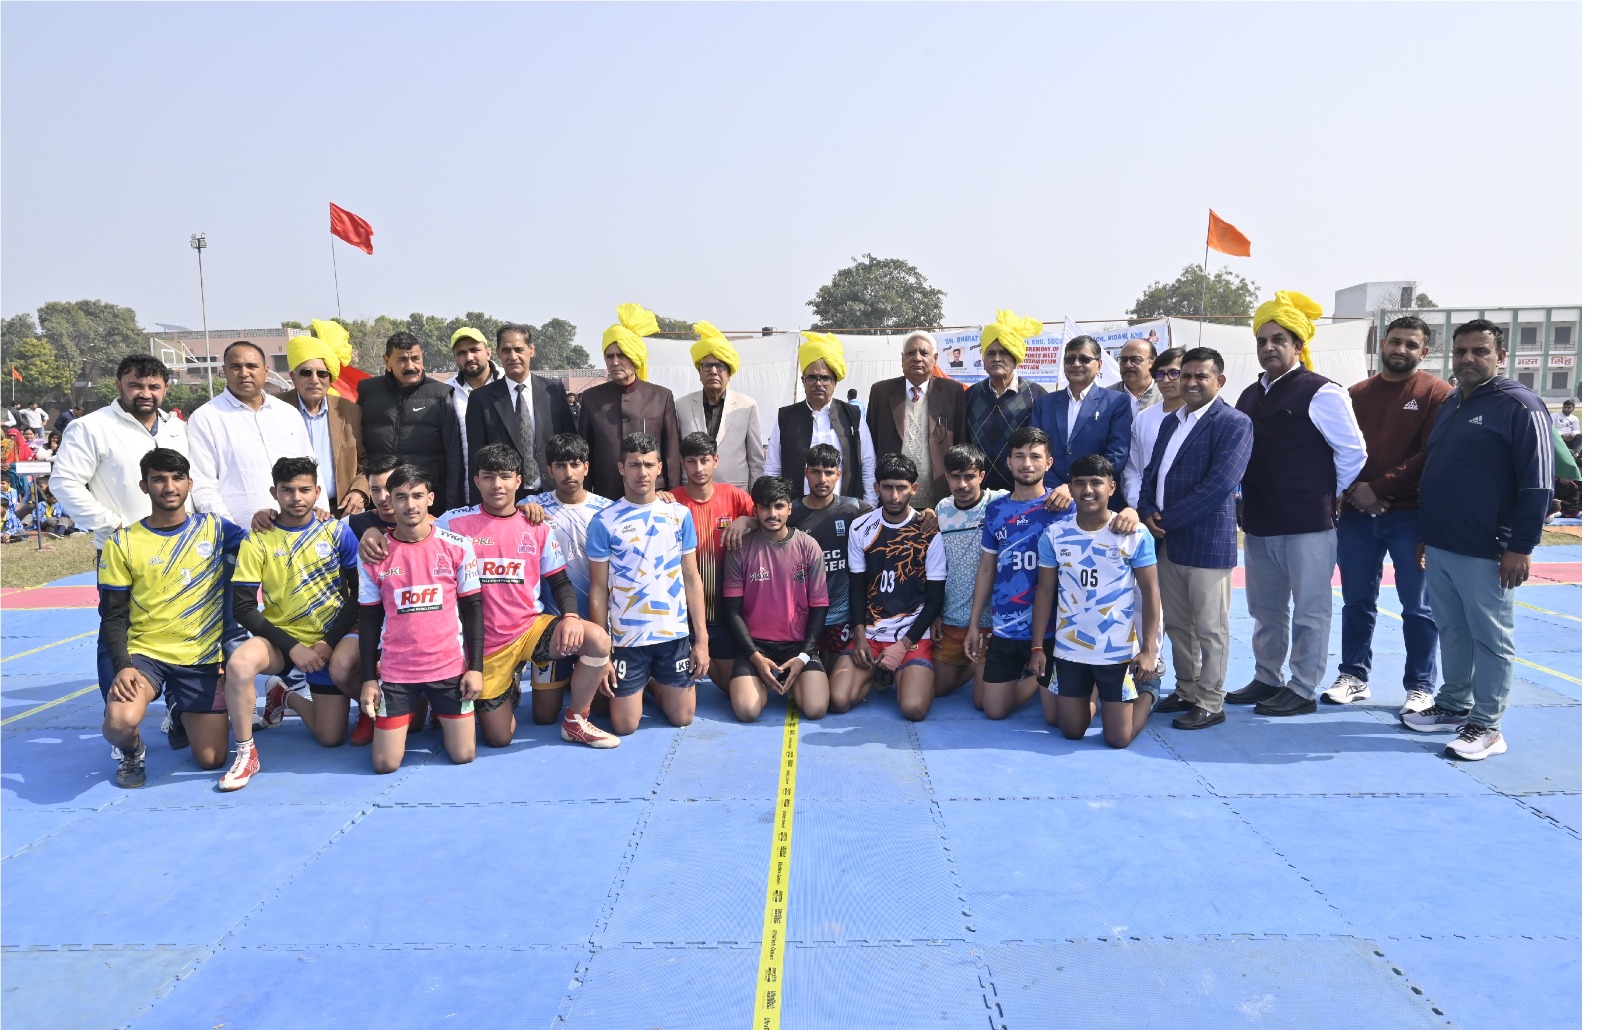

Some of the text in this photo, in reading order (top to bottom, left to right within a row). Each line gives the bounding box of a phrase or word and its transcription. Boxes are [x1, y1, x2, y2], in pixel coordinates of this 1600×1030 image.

[956, 335, 979, 343] BHARAT
[1551, 356, 1572, 366] सिंह
[441, 530, 463, 543] TYKA
[482, 561, 522, 576] Roff
[1012, 551, 1037, 571] 30
[180, 568, 191, 586] 3
[880, 569, 895, 593] 03
[1080, 568, 1099, 588] 05
[401, 587, 438, 606] Roff
